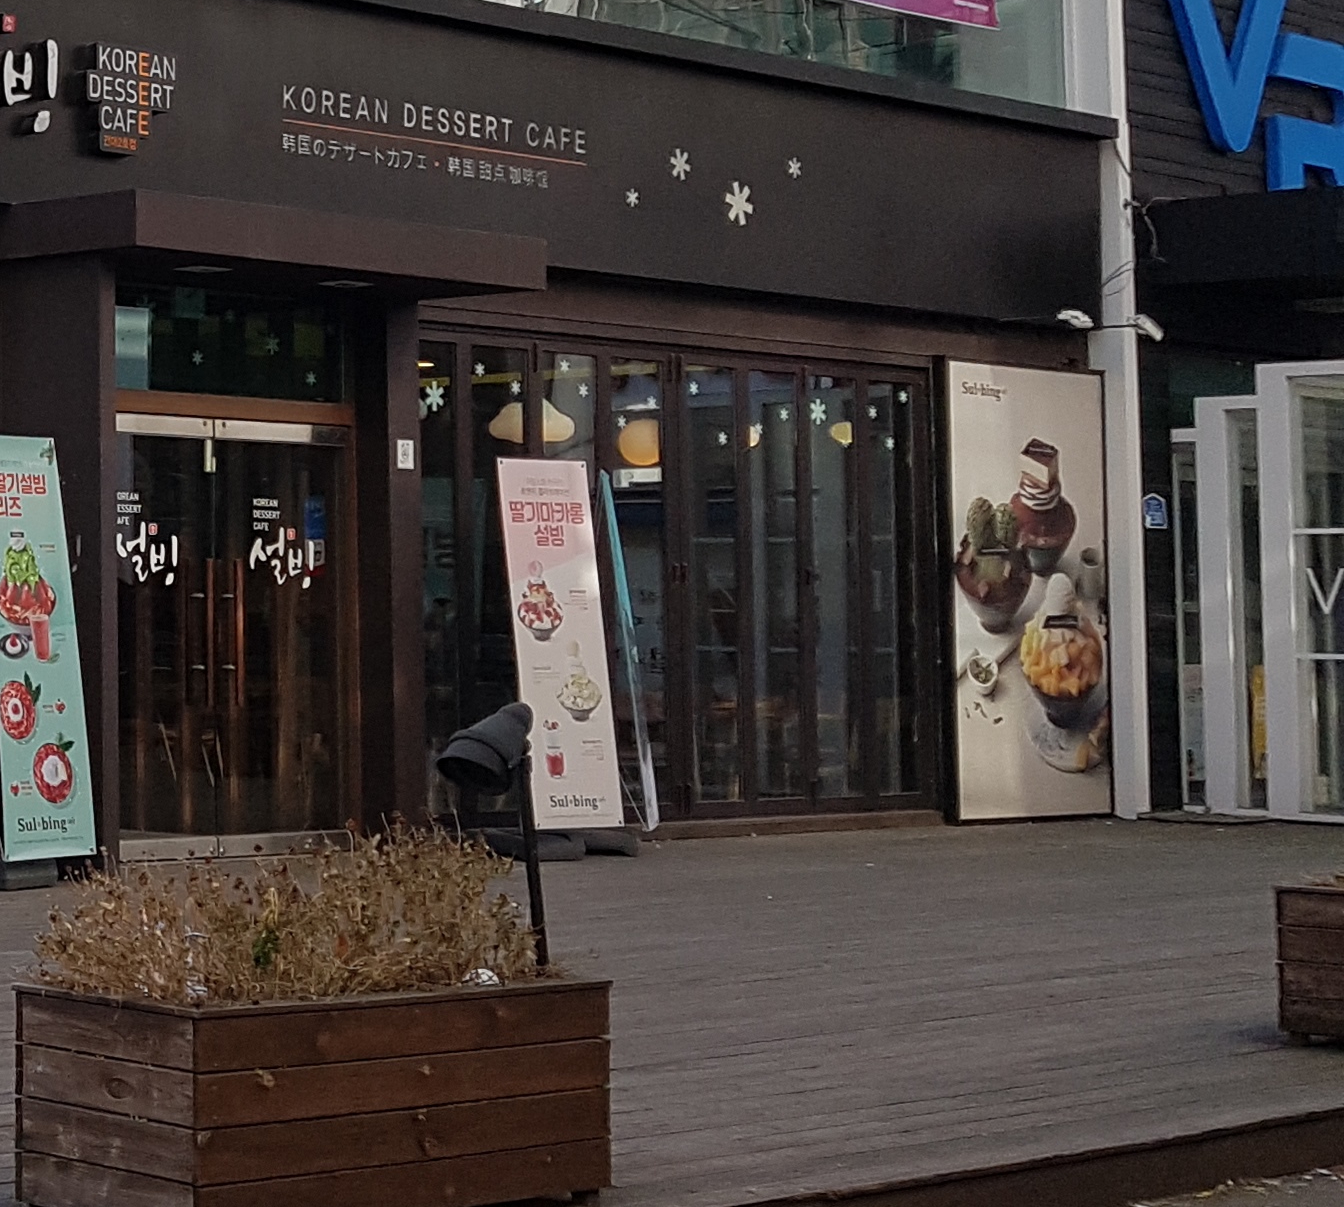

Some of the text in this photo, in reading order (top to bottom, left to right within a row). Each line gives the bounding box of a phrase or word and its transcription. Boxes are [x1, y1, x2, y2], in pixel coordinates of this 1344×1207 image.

[99, 46, 176, 81] KOREAN
[89, 74, 174, 109] DESSERT
[101, 106, 149, 135] CAFE
[282, 84, 587, 154] KOREAN DESSERT CAFE
[253, 498, 278, 507] KOREAN
[253, 510, 280, 519] DESSERT
[509, 501, 584, 524] 딸기마카롱
[253, 522, 269, 531] CAFE
[534, 525, 564, 546] 설빙
[250, 527, 313, 589] 설빙
